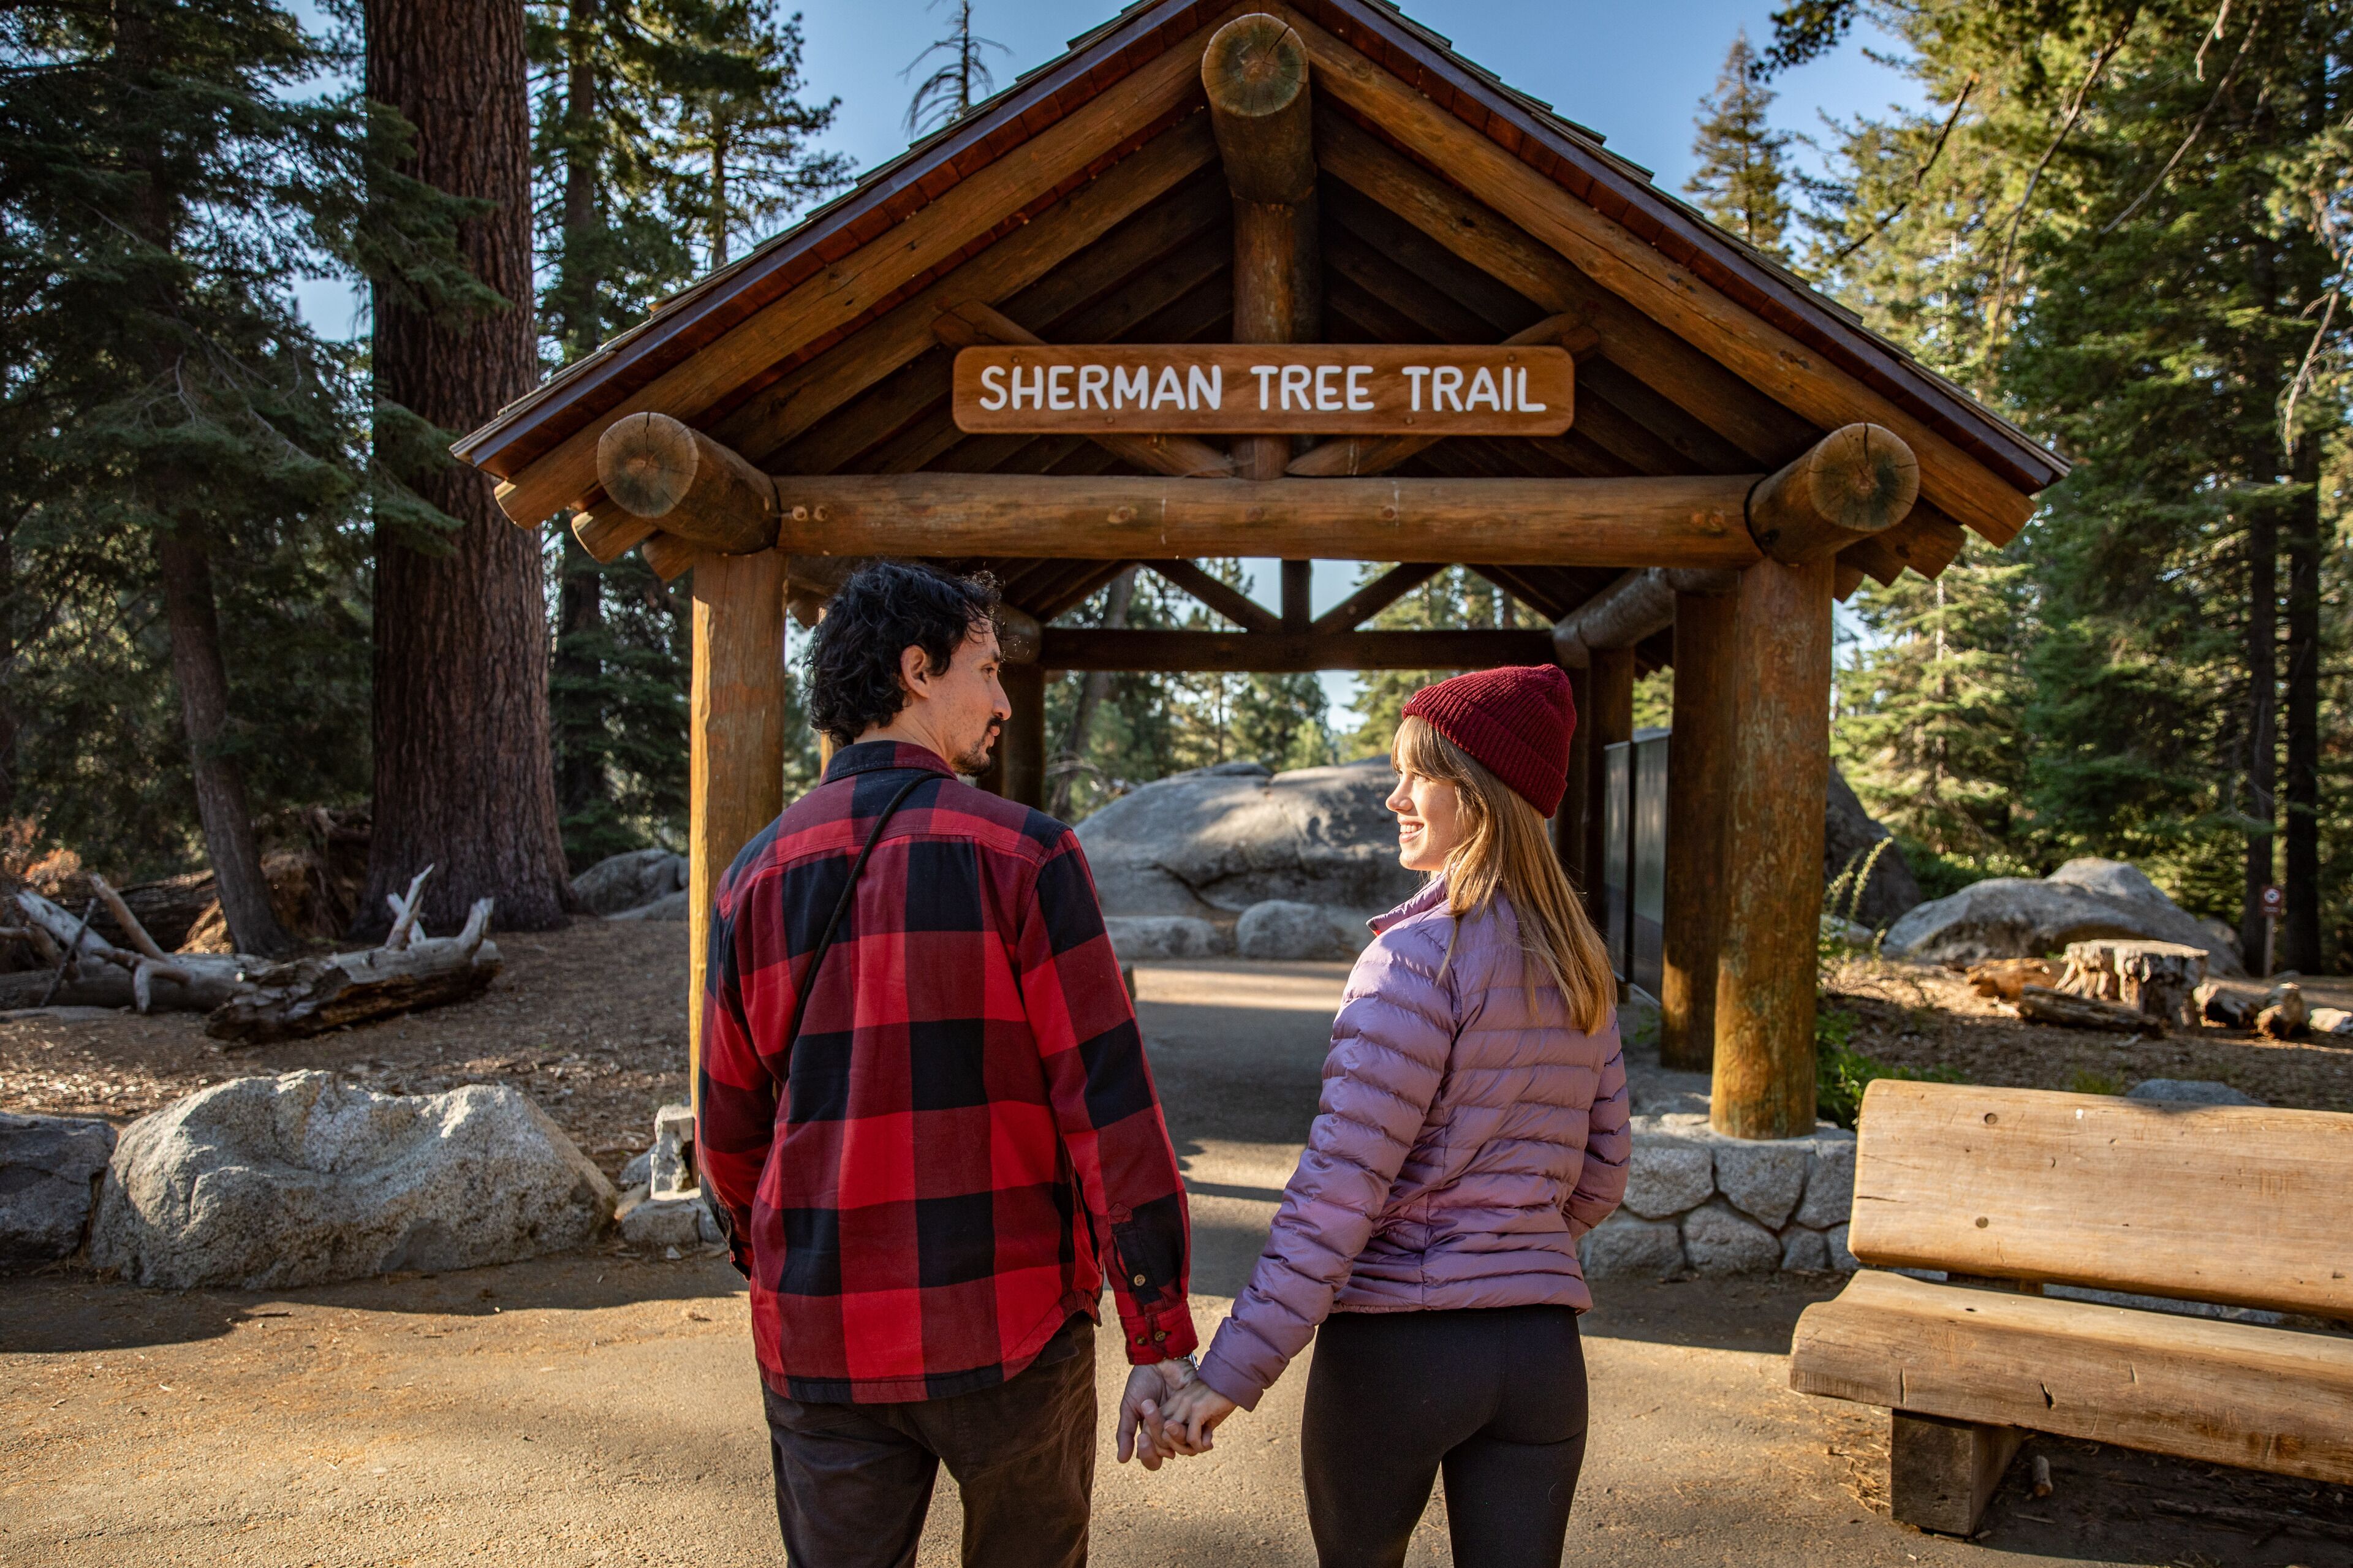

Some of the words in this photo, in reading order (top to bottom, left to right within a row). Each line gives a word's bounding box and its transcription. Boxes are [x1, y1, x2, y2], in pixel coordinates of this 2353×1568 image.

[979, 365, 1222, 411] SHERMAN
[1249, 365, 1375, 412] TREE
[1401, 365, 1547, 413] TRAIL
